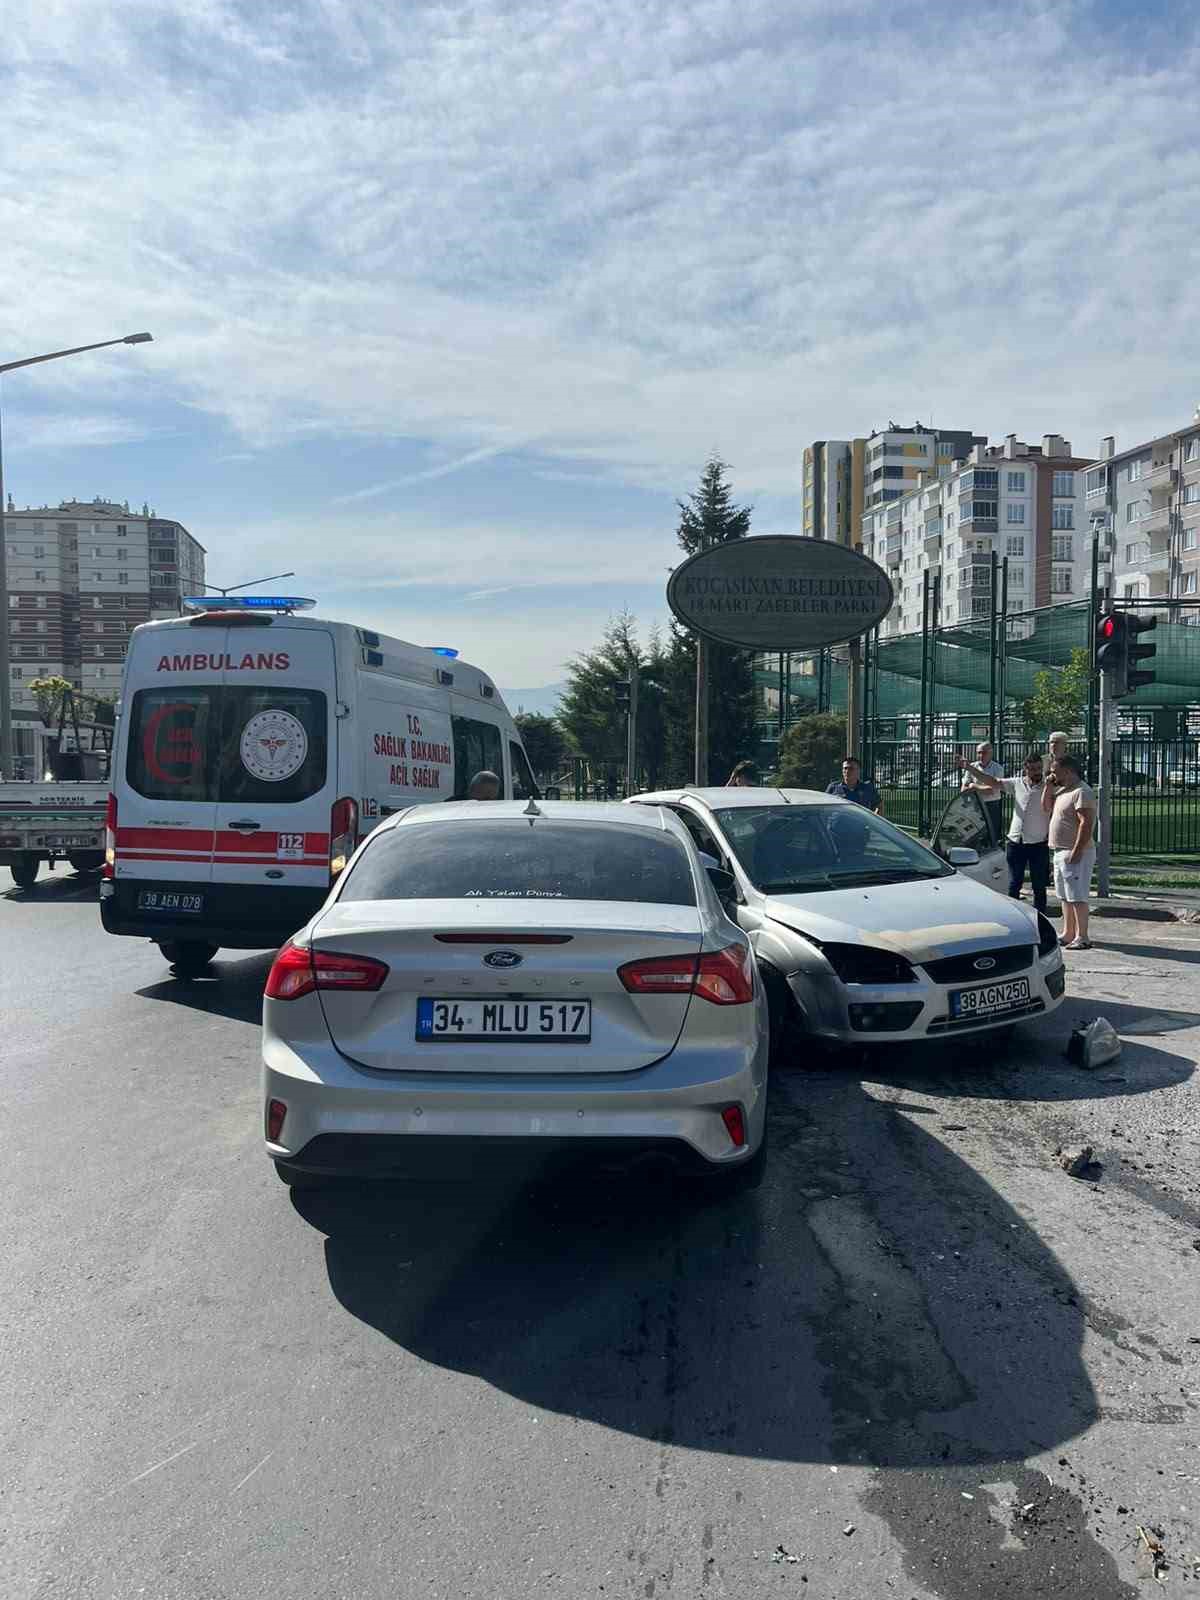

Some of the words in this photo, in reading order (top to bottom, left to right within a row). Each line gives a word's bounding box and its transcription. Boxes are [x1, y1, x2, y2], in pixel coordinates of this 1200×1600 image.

[709, 599, 750, 613] MART
[756, 599, 829, 614] ZAFERLER
[157, 652, 290, 672] AMBULANS
[406, 714, 423, 736] T.C.
[373, 731, 407, 758] SAĞLIK
[410, 740, 452, 765] BAKANLIĞI
[390, 761, 409, 786] ACİL
[412, 764, 440, 789] SAĞLIK
[361, 797, 377, 816] 112
[280, 834, 304, 849] 112
[160, 894, 180, 907] AEN
[182, 896, 201, 909] 078
[487, 888, 522, 897] Yalan
[435, 1004, 464, 1032] 34
[482, 1004, 529, 1032] MLU
[539, 1004, 585, 1032] 517
